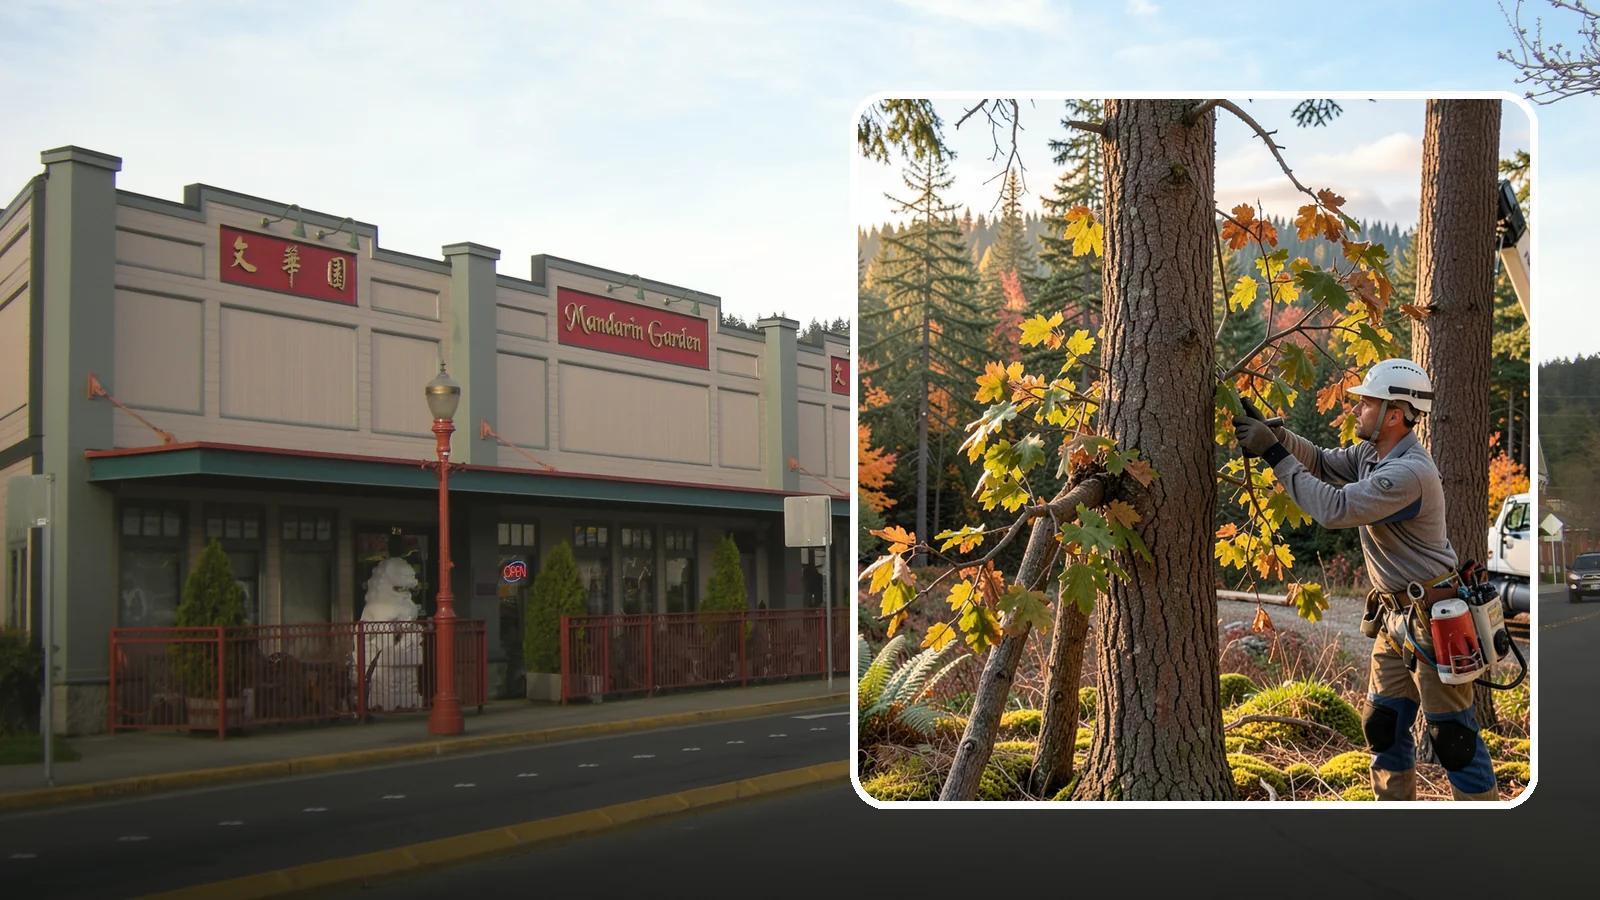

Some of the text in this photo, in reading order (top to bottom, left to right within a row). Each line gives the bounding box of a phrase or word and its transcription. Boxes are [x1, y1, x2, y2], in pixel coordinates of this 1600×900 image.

[230, 235, 346, 291] 文華園
[564, 302, 702, 352] Mandarin Garden
[503, 565, 527, 578] OPEN
